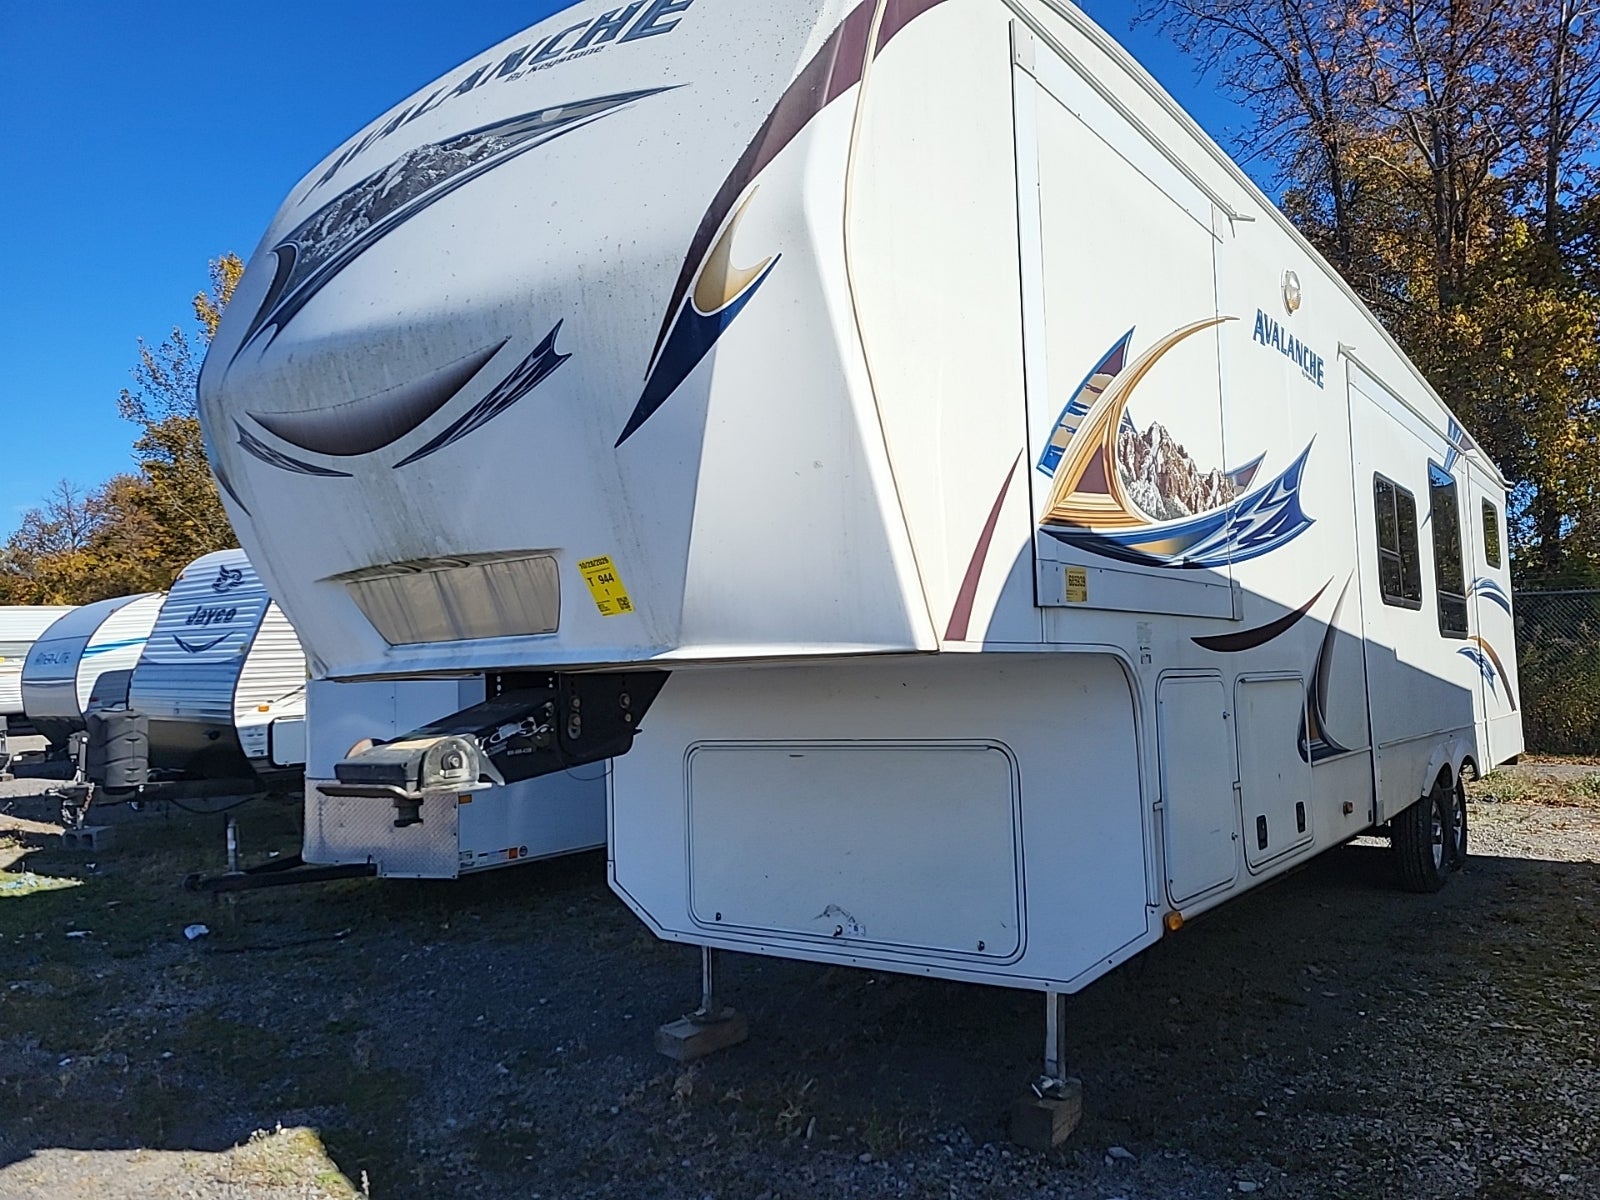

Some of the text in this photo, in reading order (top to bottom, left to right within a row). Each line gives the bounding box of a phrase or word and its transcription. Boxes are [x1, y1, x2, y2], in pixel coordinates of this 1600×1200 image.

[504, 45, 606, 83] By Keystone
[1253, 308, 1324, 390] AVALANCHE
[587, 573, 614, 587] T 944
[185, 605, 237, 627] Jayco
